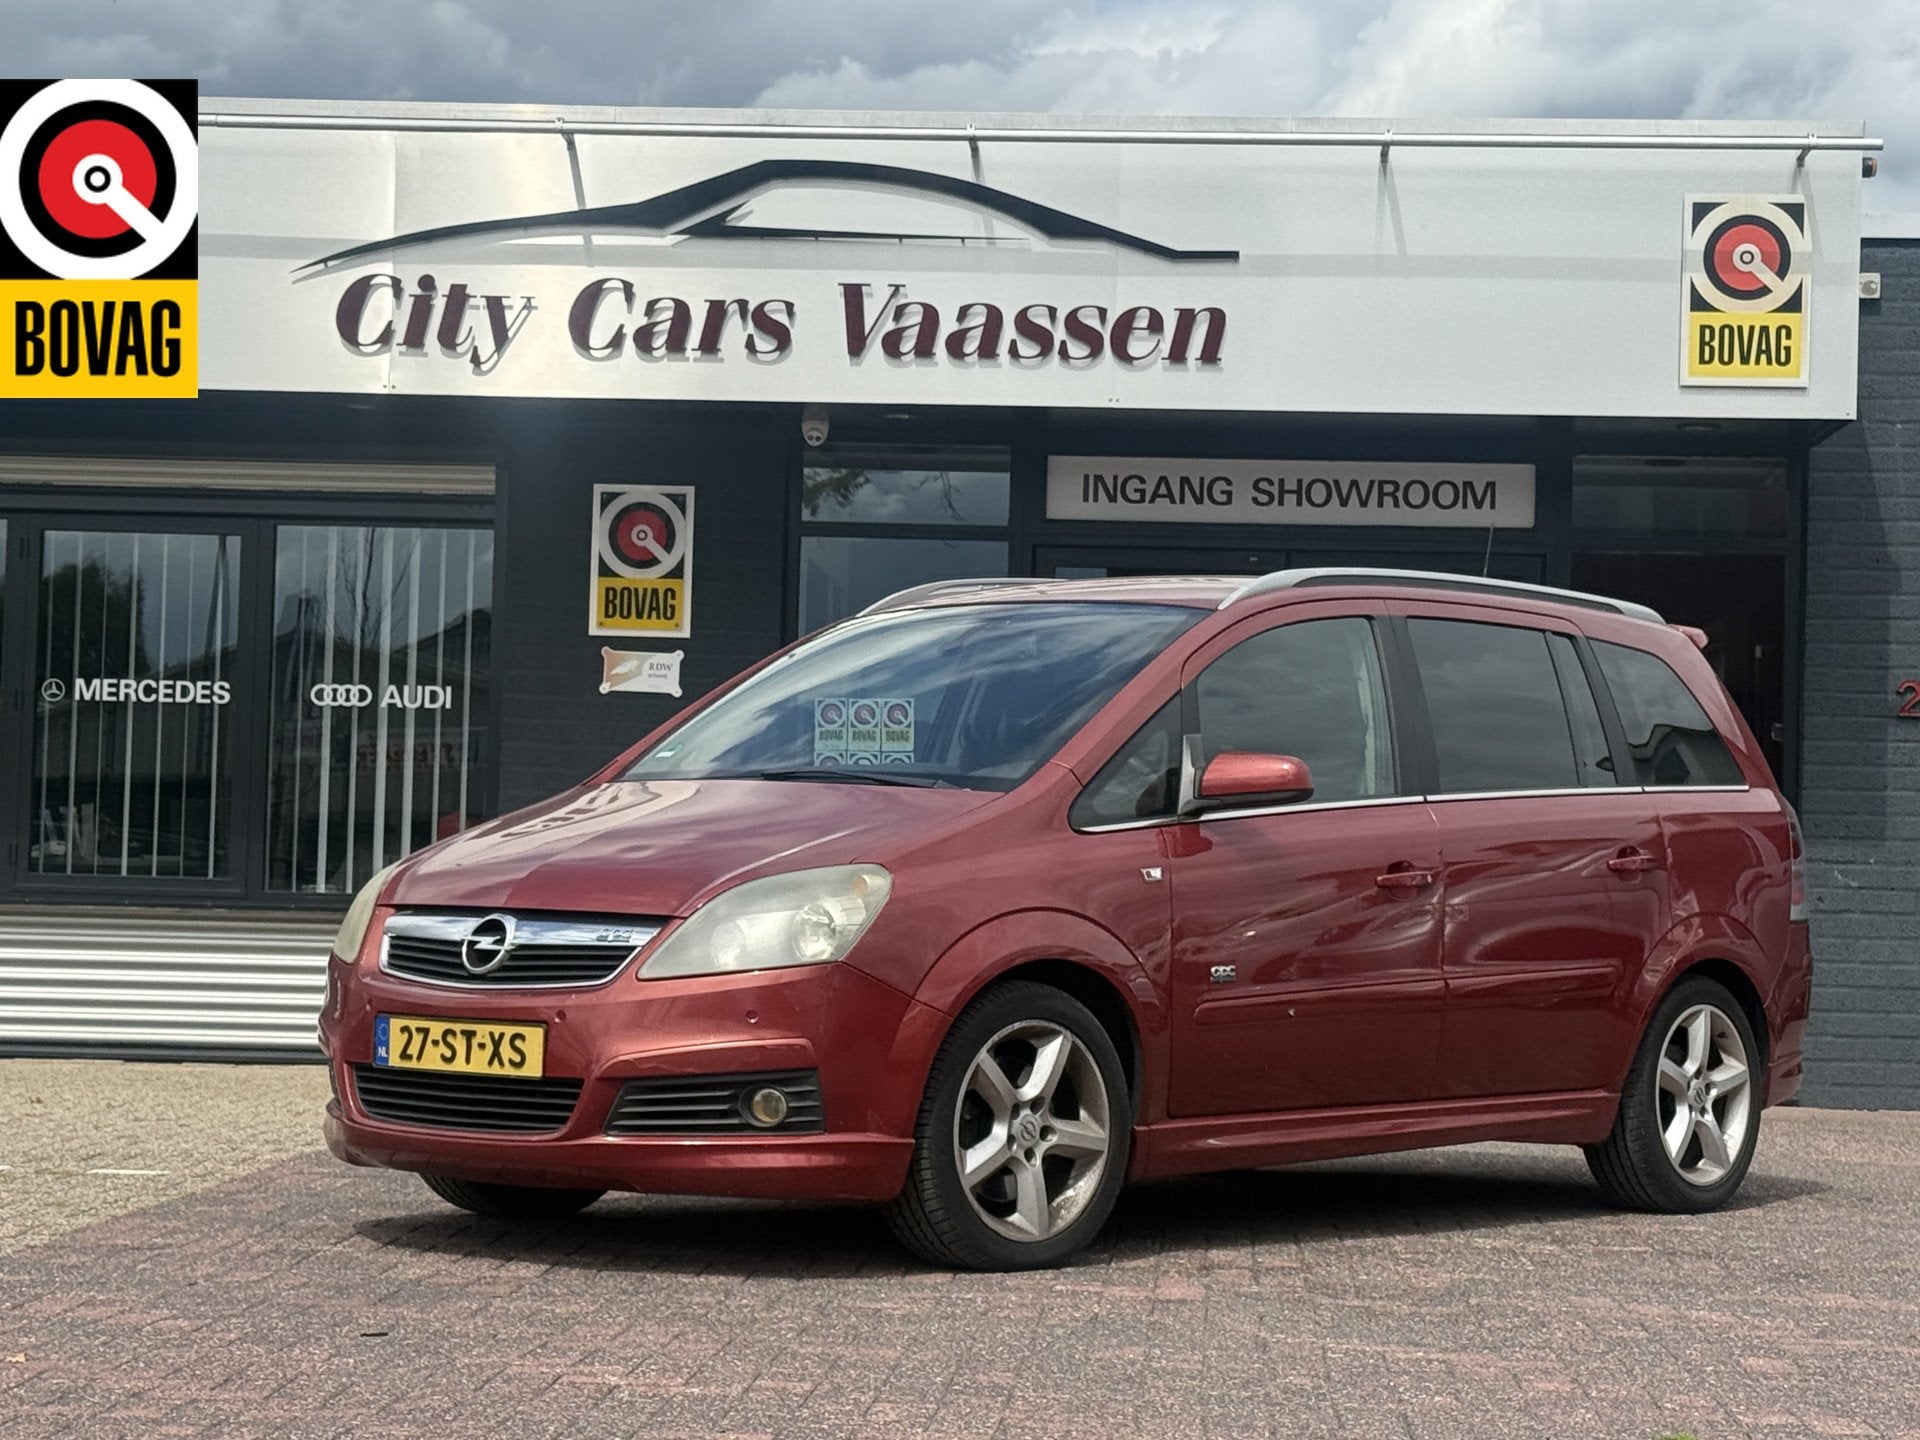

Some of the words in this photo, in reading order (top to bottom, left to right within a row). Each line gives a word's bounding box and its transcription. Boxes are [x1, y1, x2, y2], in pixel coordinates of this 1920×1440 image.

[336, 273, 535, 366] City
[568, 277, 796, 355] Cars
[837, 282, 1227, 364] Vaassen
[1698, 323, 1793, 367] BOVAG
[1082, 473, 1233, 506] INGANG
[1251, 476, 1497, 510] SHOWROOM
[603, 586, 677, 621] BOVAG
[648, 662, 674, 672] RDW
[74, 678, 231, 705] MERCEDES
[379, 683, 452, 710] AUDI
[819, 729, 843, 742] BOVAG
[852, 730, 876, 742] BOVAG
[885, 730, 910, 742] BOVAG
[377, 1046, 388, 1058] NL
[398, 1024, 527, 1070] 27-ST-XS
